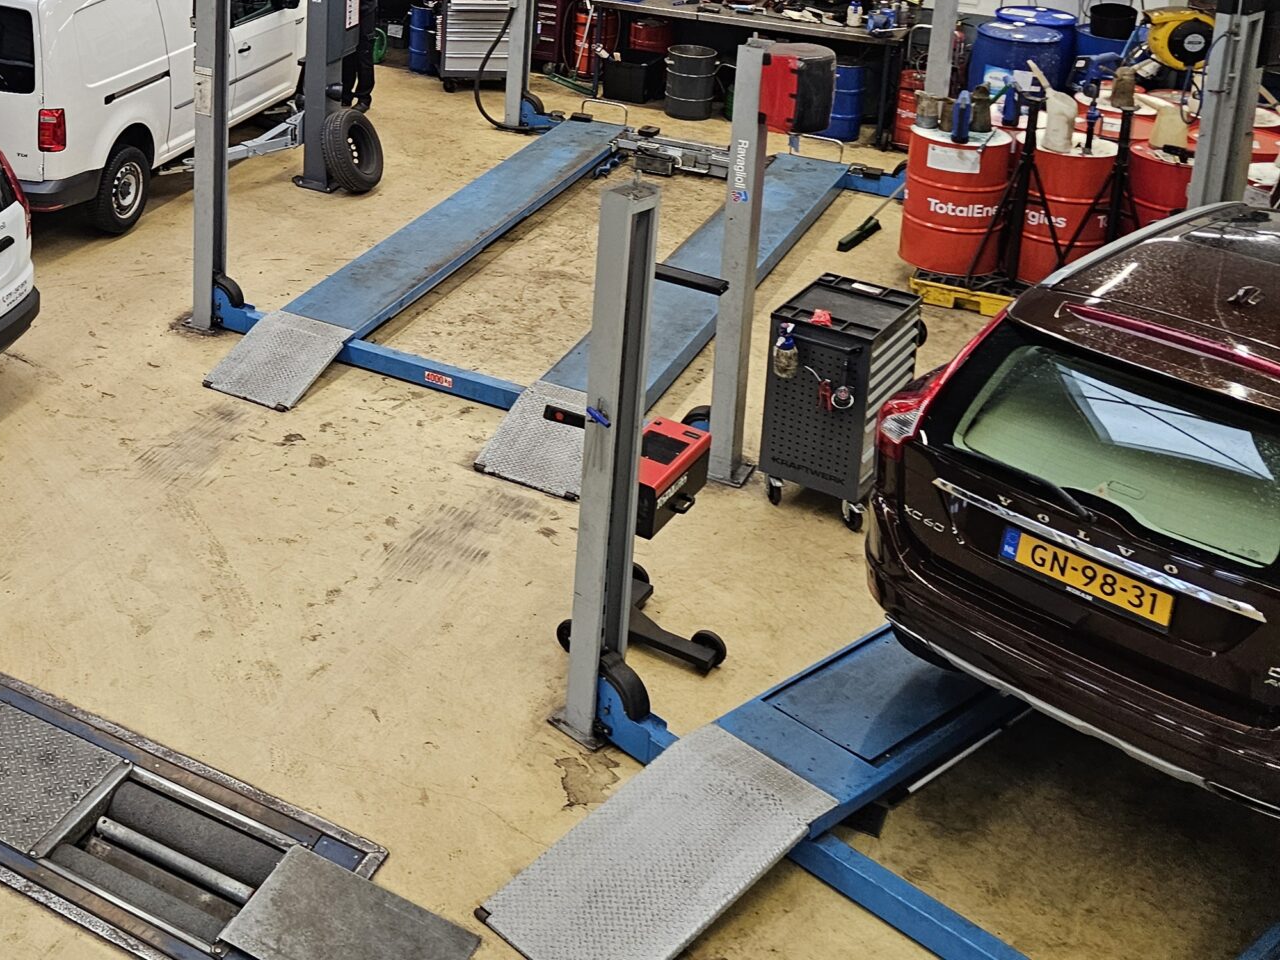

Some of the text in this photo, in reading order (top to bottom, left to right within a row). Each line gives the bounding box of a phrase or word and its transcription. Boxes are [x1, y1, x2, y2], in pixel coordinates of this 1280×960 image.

[772, 456, 846, 486] KRAFTWERK
[997, 494, 1180, 575] VOLVO
[1031, 544, 1158, 615] GN-98-31
